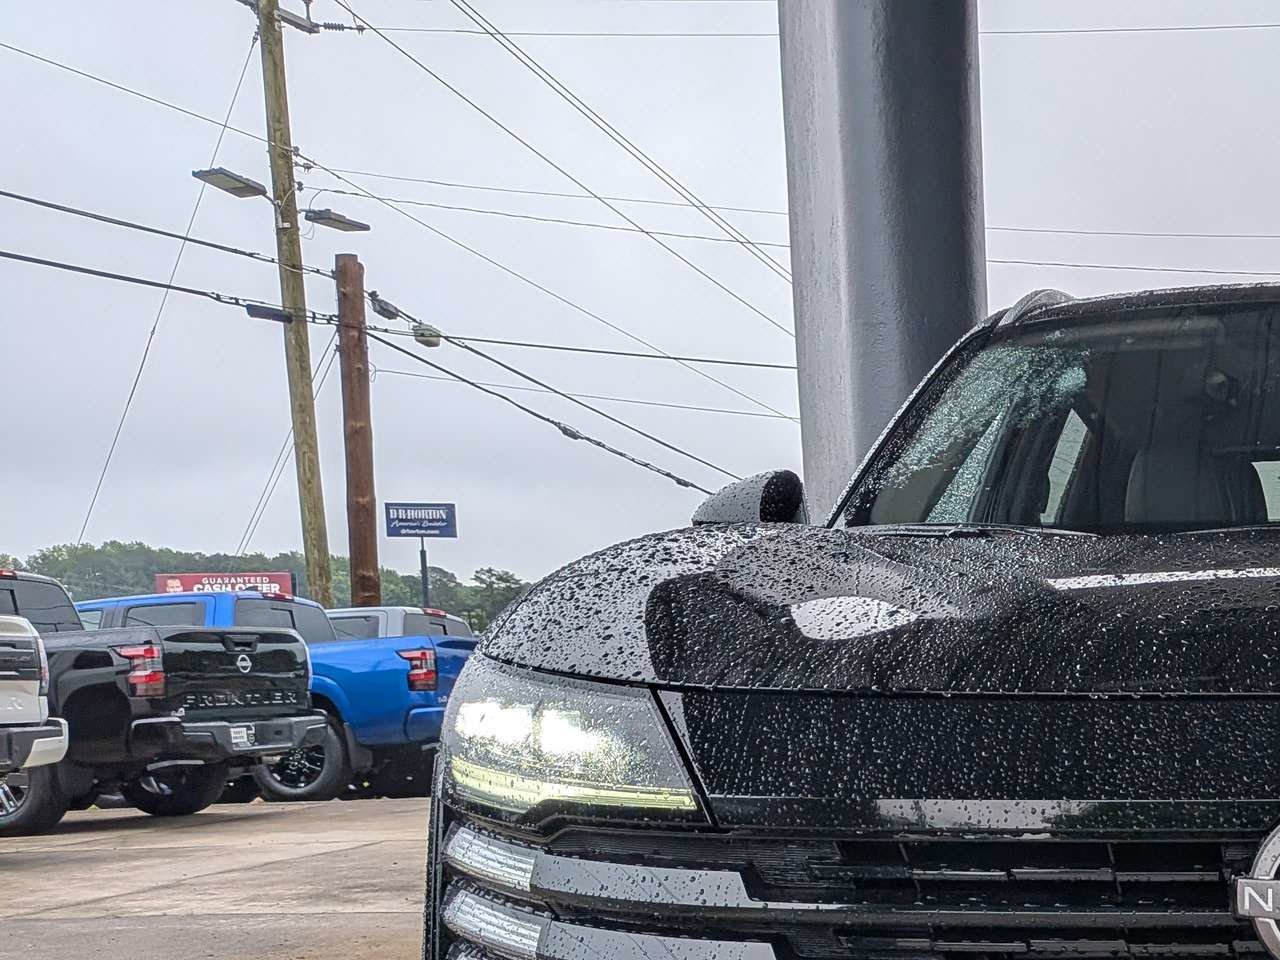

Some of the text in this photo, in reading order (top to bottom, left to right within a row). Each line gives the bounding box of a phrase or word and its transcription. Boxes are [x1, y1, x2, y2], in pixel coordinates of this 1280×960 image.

[201, 576, 269, 584] GUARANTEED
[193, 583, 280, 594] CASH OER
